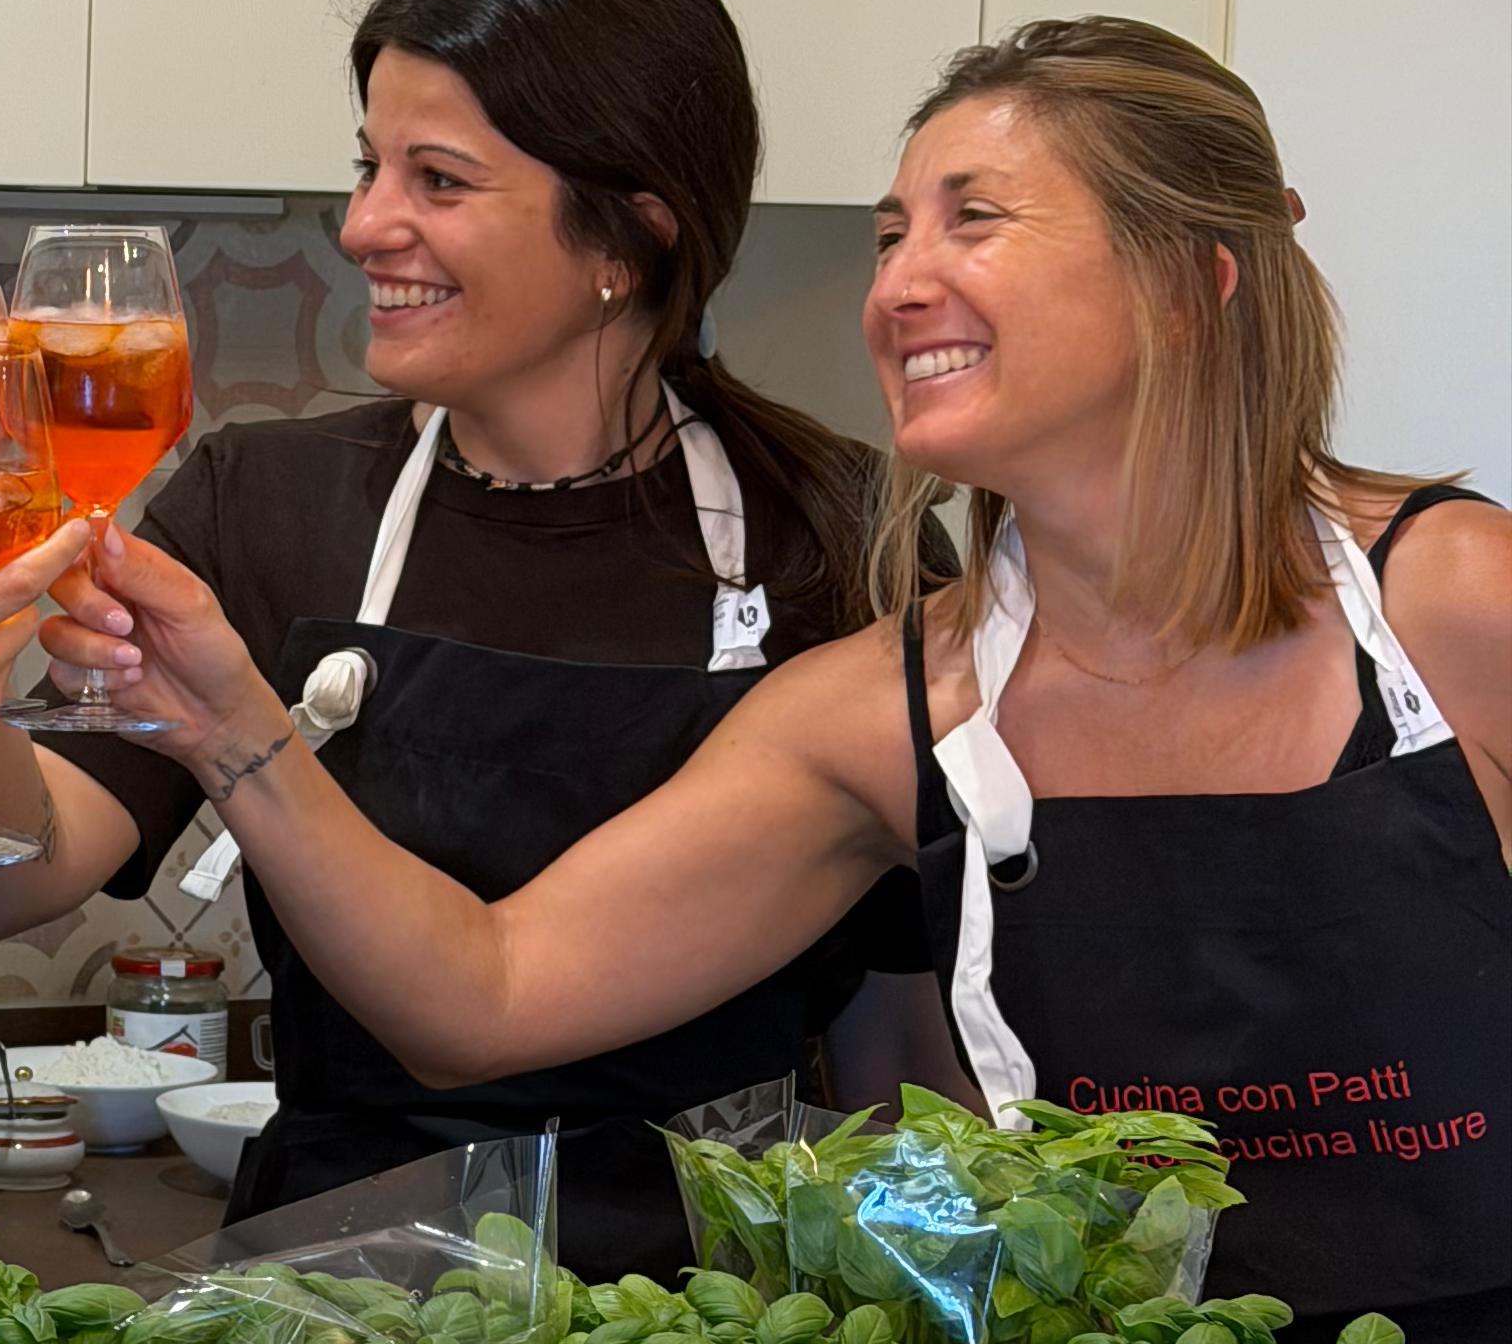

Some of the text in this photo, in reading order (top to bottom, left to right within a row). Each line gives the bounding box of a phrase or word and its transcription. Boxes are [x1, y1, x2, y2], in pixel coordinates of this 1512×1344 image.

[1069, 1059, 1412, 1114] Cucina con Patti
[1368, 1111, 1487, 1161] ligure
